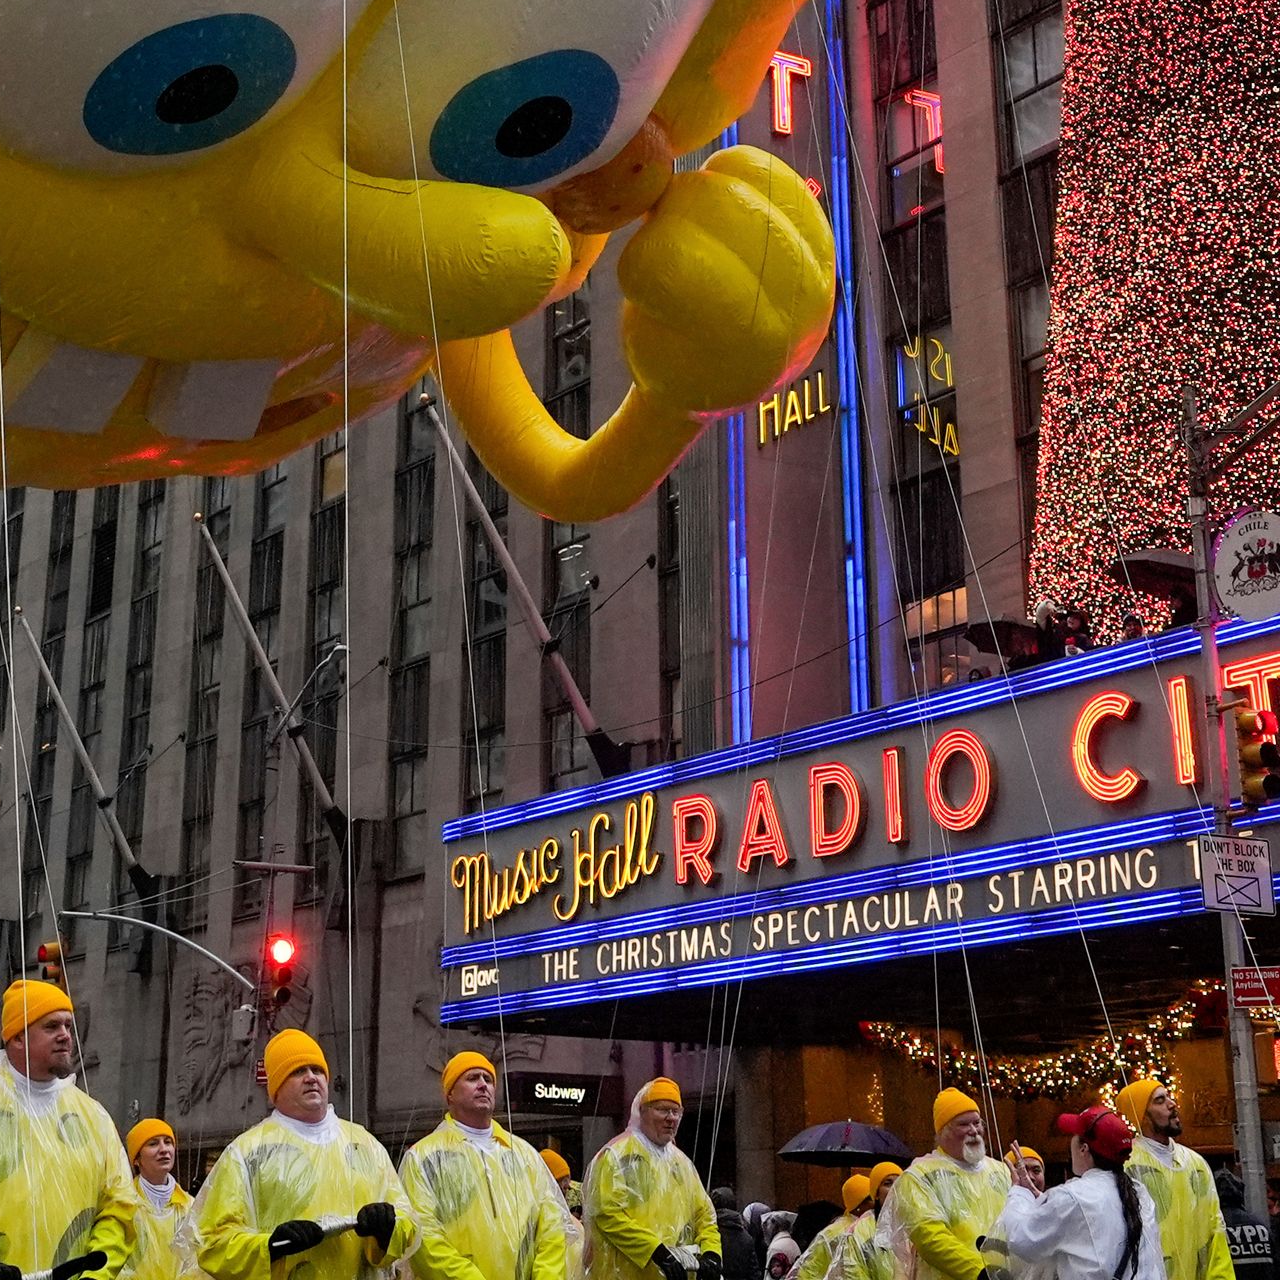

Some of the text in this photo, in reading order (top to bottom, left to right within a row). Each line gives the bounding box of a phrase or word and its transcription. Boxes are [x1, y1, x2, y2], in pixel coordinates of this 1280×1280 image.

[758, 370, 832, 445] HALL
[1238, 521, 1270, 537] CHILE
[672, 727, 993, 885] RADIO
[1204, 840, 1265, 858] DON'T BLOCK
[452, 790, 660, 933] Music Hall
[1216, 858, 1256, 873] THE BOX
[541, 948, 580, 983] THE
[596, 923, 732, 975] CHRISTMAS
[752, 883, 965, 950] SPECTACULAR
[988, 848, 1158, 914] STARRING
[1245, 971, 1280, 979] STANDING
[535, 1083, 586, 1103] Subway
[1230, 1243, 1272, 1256] OLICE
